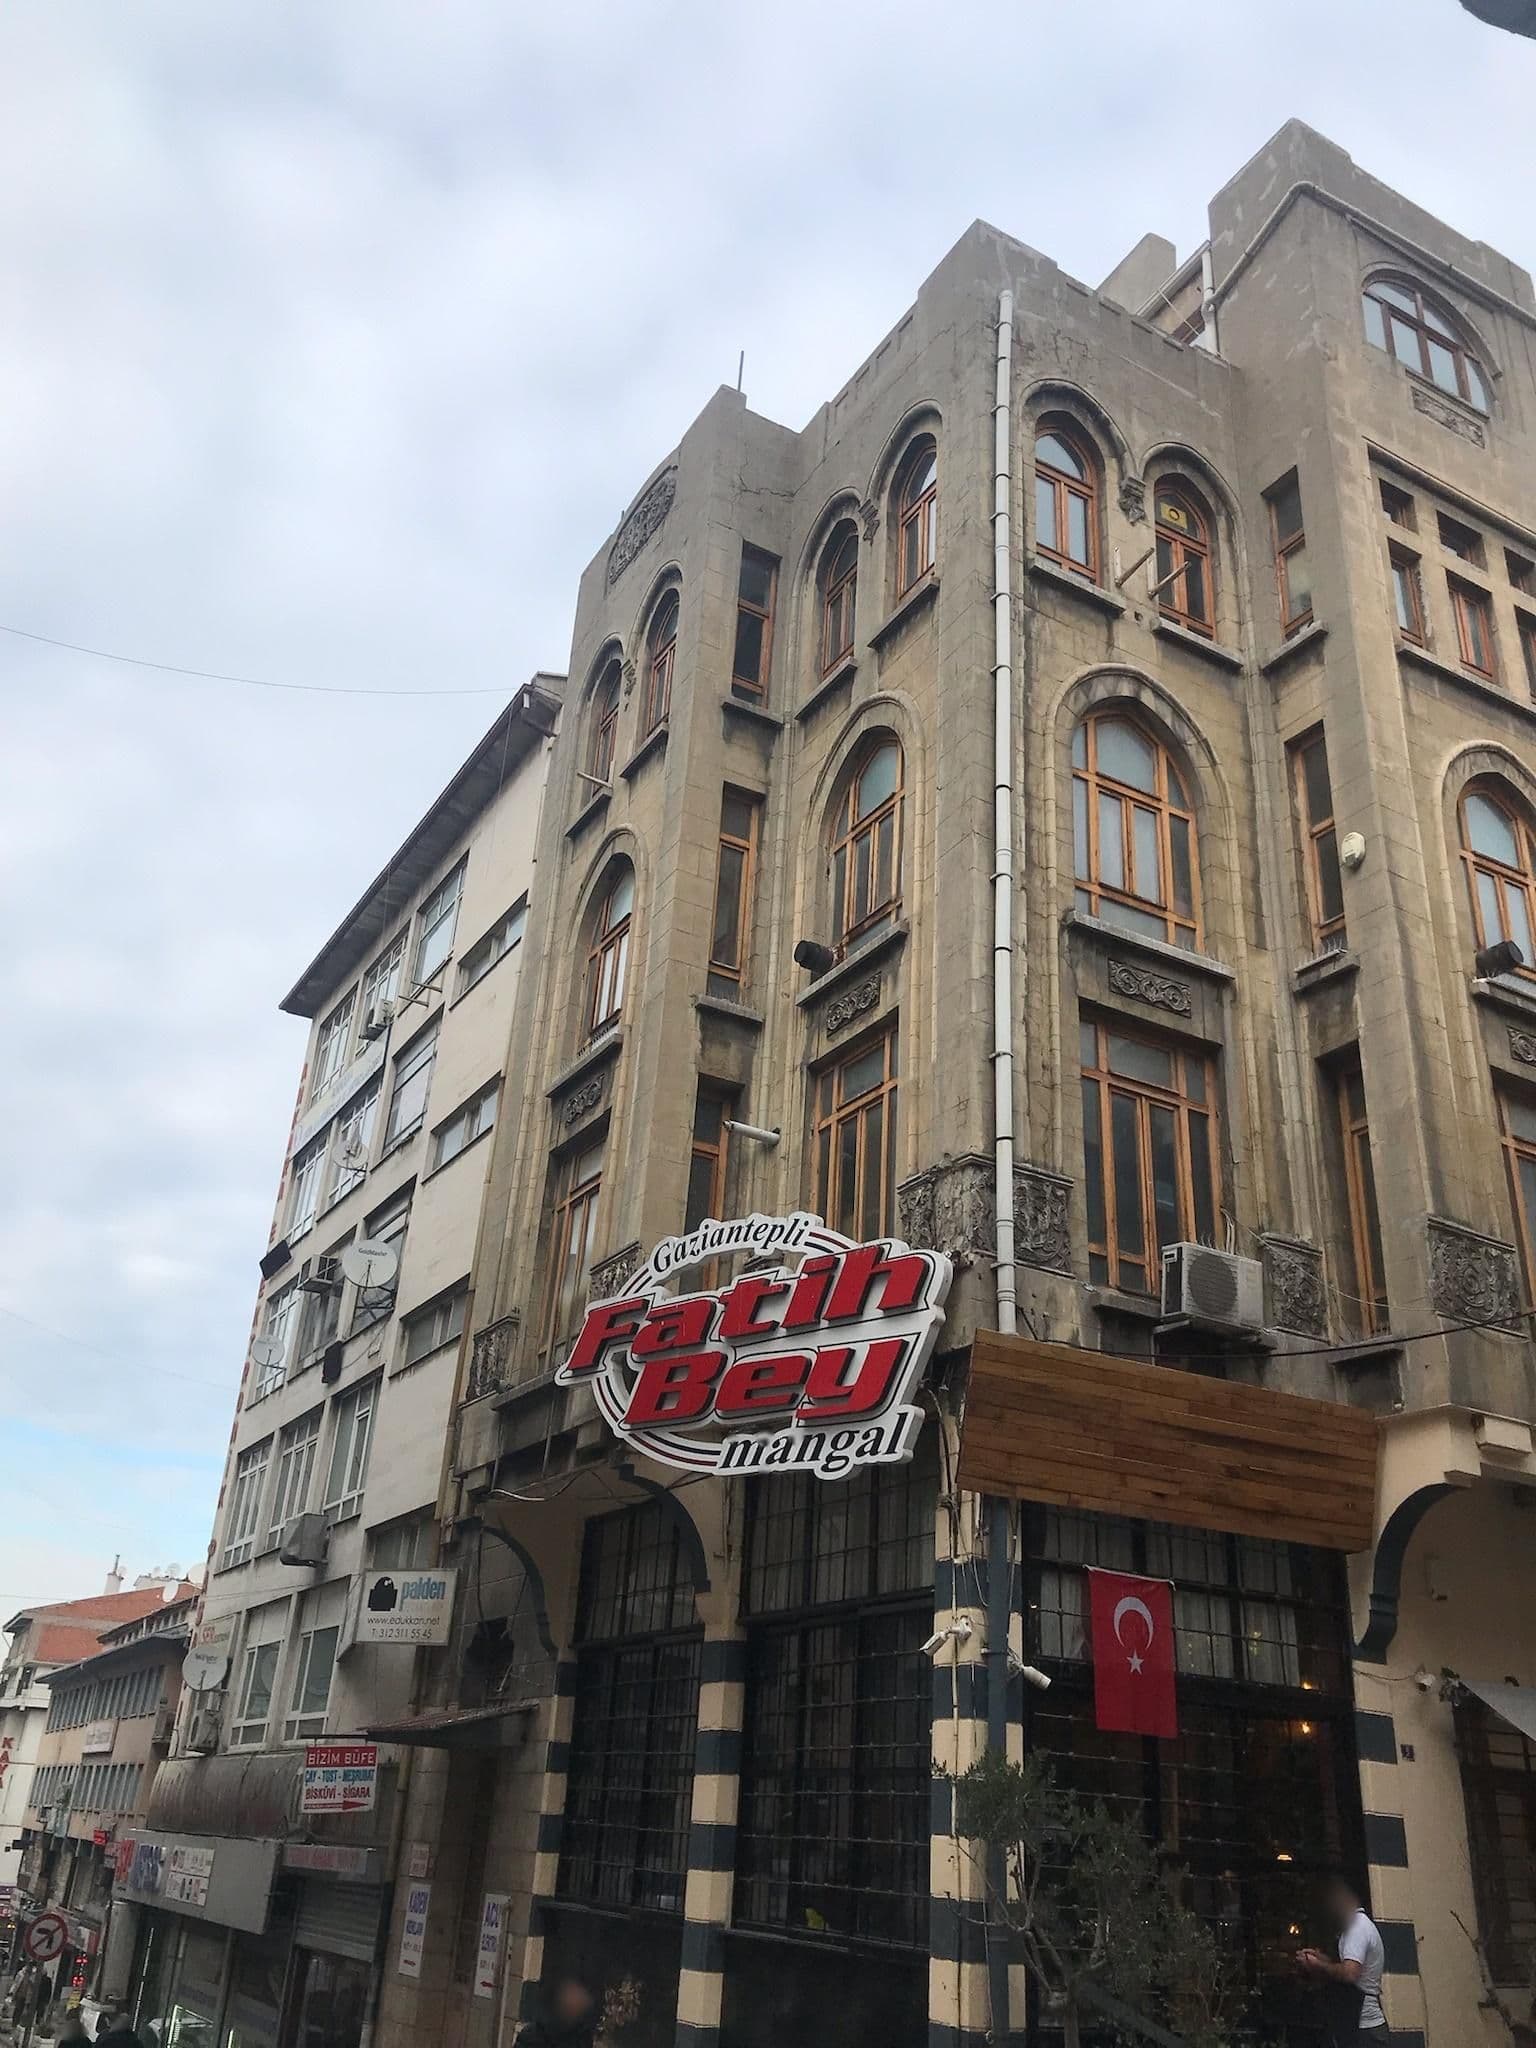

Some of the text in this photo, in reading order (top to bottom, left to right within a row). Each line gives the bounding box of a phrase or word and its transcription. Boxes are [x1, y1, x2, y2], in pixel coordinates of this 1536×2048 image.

[654, 1218, 810, 1274] Gaziantepli
[566, 1244, 929, 1373] Fatih
[625, 1338, 908, 1426] Bey
[719, 1411, 904, 1473] mangal
[400, 1577, 447, 1612] palden
[379, 1628, 394, 1638] 312
[395, 1628, 409, 1638] 311
[411, 1628, 421, 1639] 55
[422, 1628, 432, 1639] 45
[0, 1736, 14, 1789] KAY
[308, 1748, 375, 1765] BİZİM BÜFE
[322, 1770, 338, 1782] TOST
[305, 1785, 337, 1800] BİSKÜVİ
[342, 1784, 371, 1799] SİGARA
